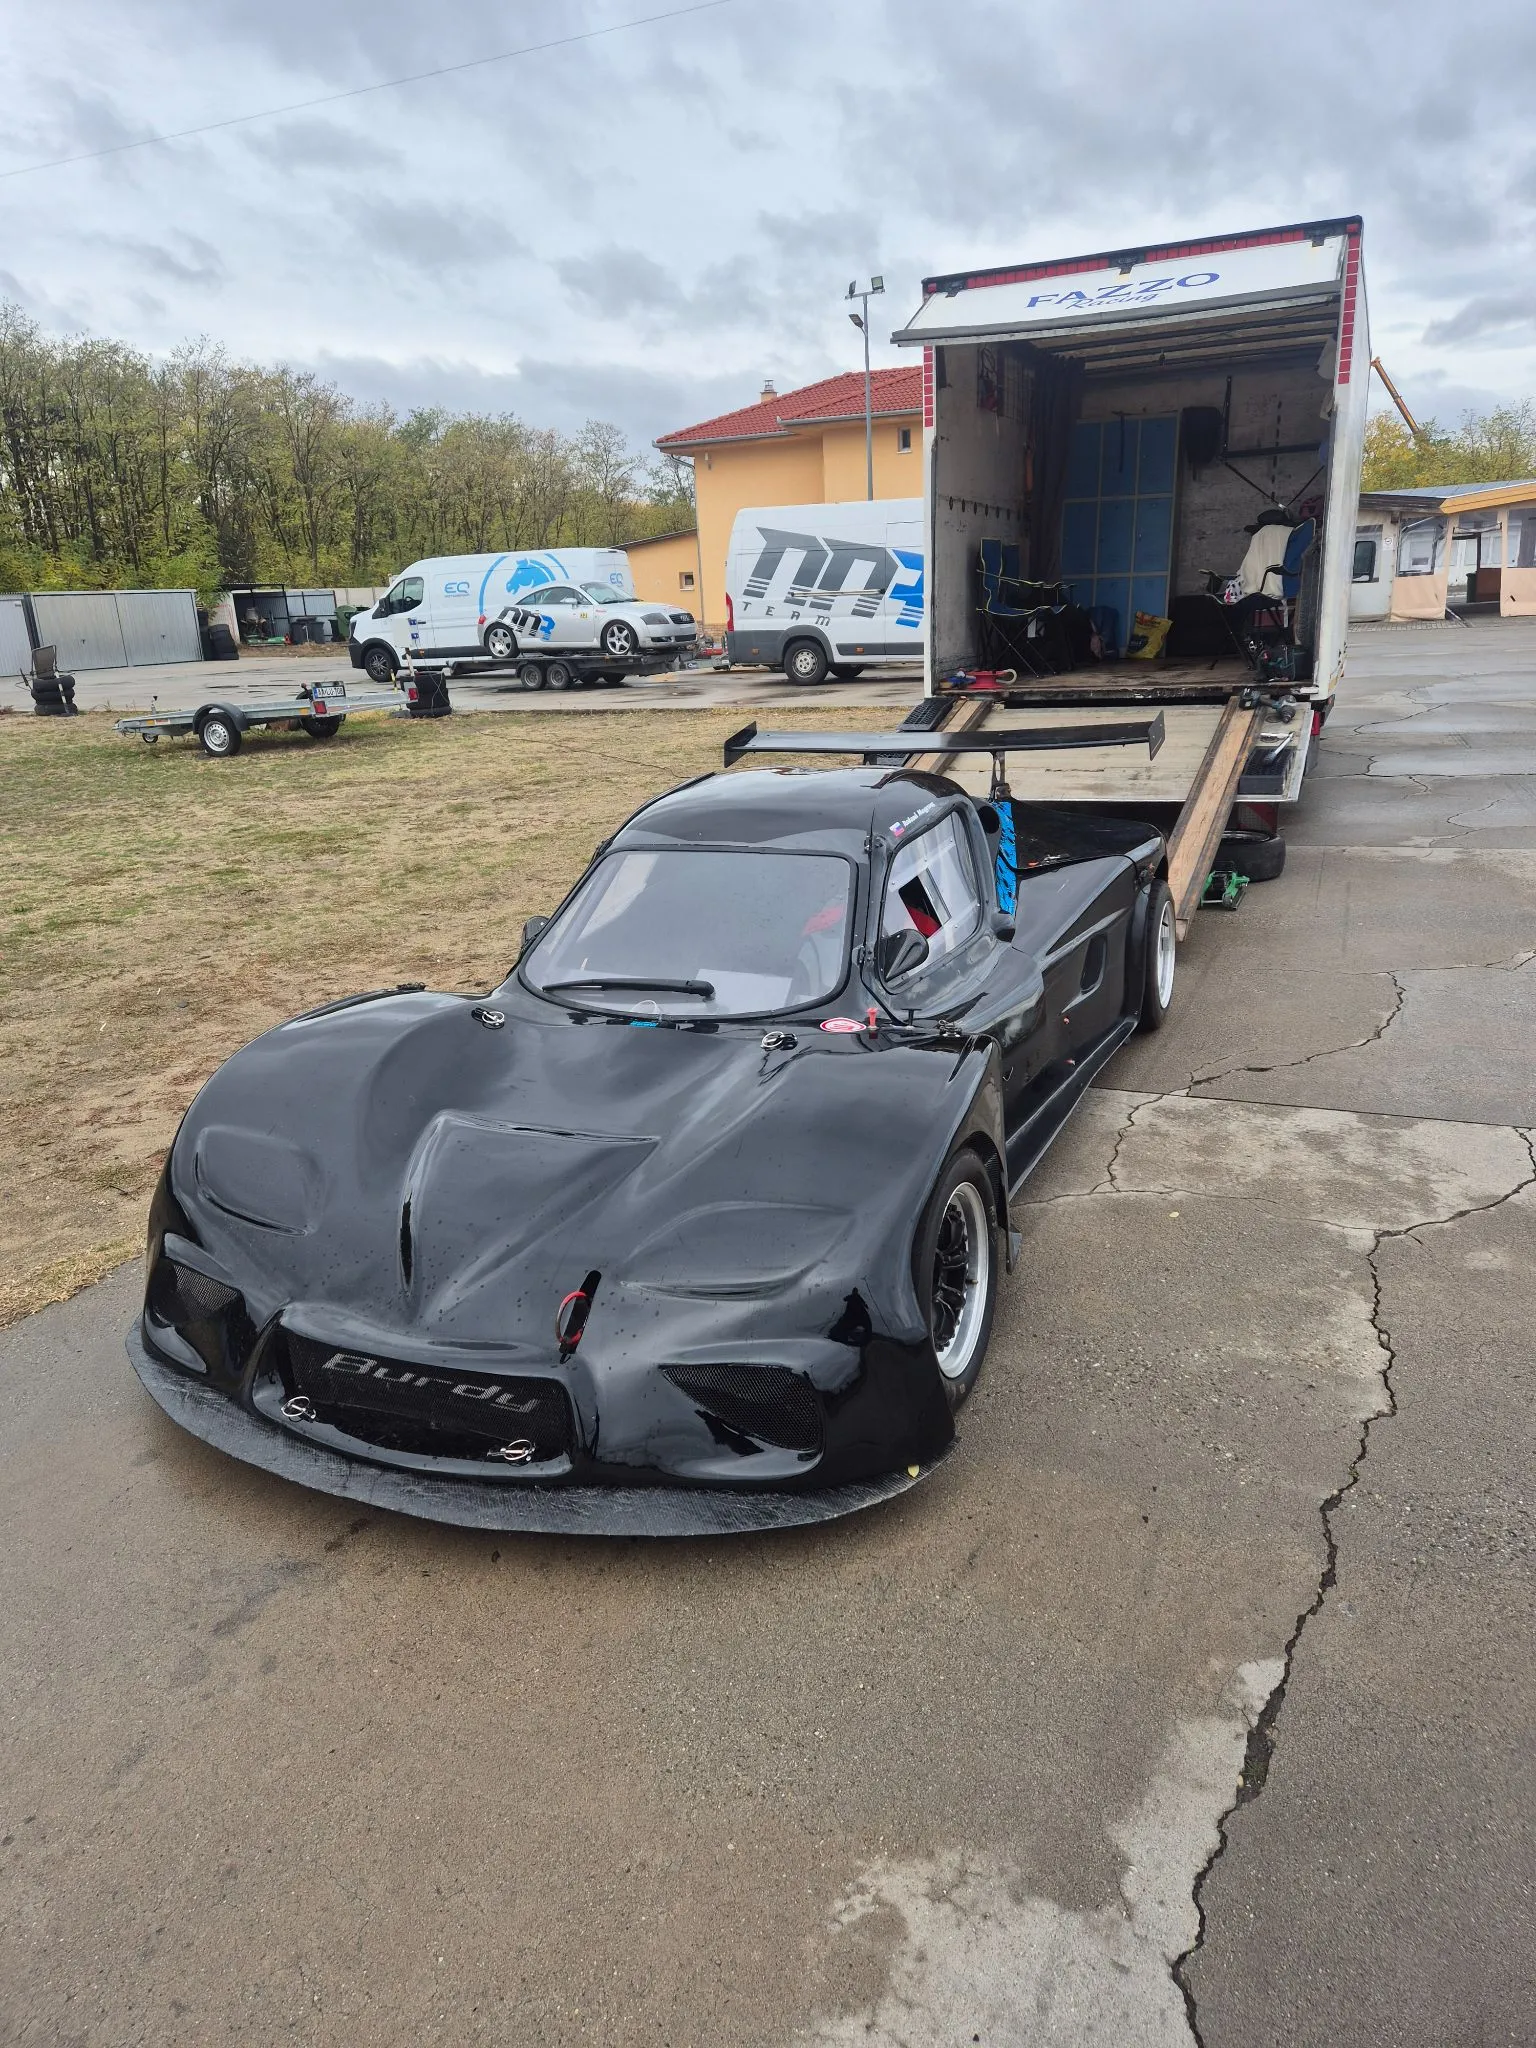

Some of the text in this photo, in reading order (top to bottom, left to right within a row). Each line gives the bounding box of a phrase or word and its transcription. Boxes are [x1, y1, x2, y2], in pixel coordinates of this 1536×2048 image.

[1024, 272, 1220, 308] FAZZO
[1065, 293, 1160, 310] Racing
[444, 581, 470, 594] EQ
